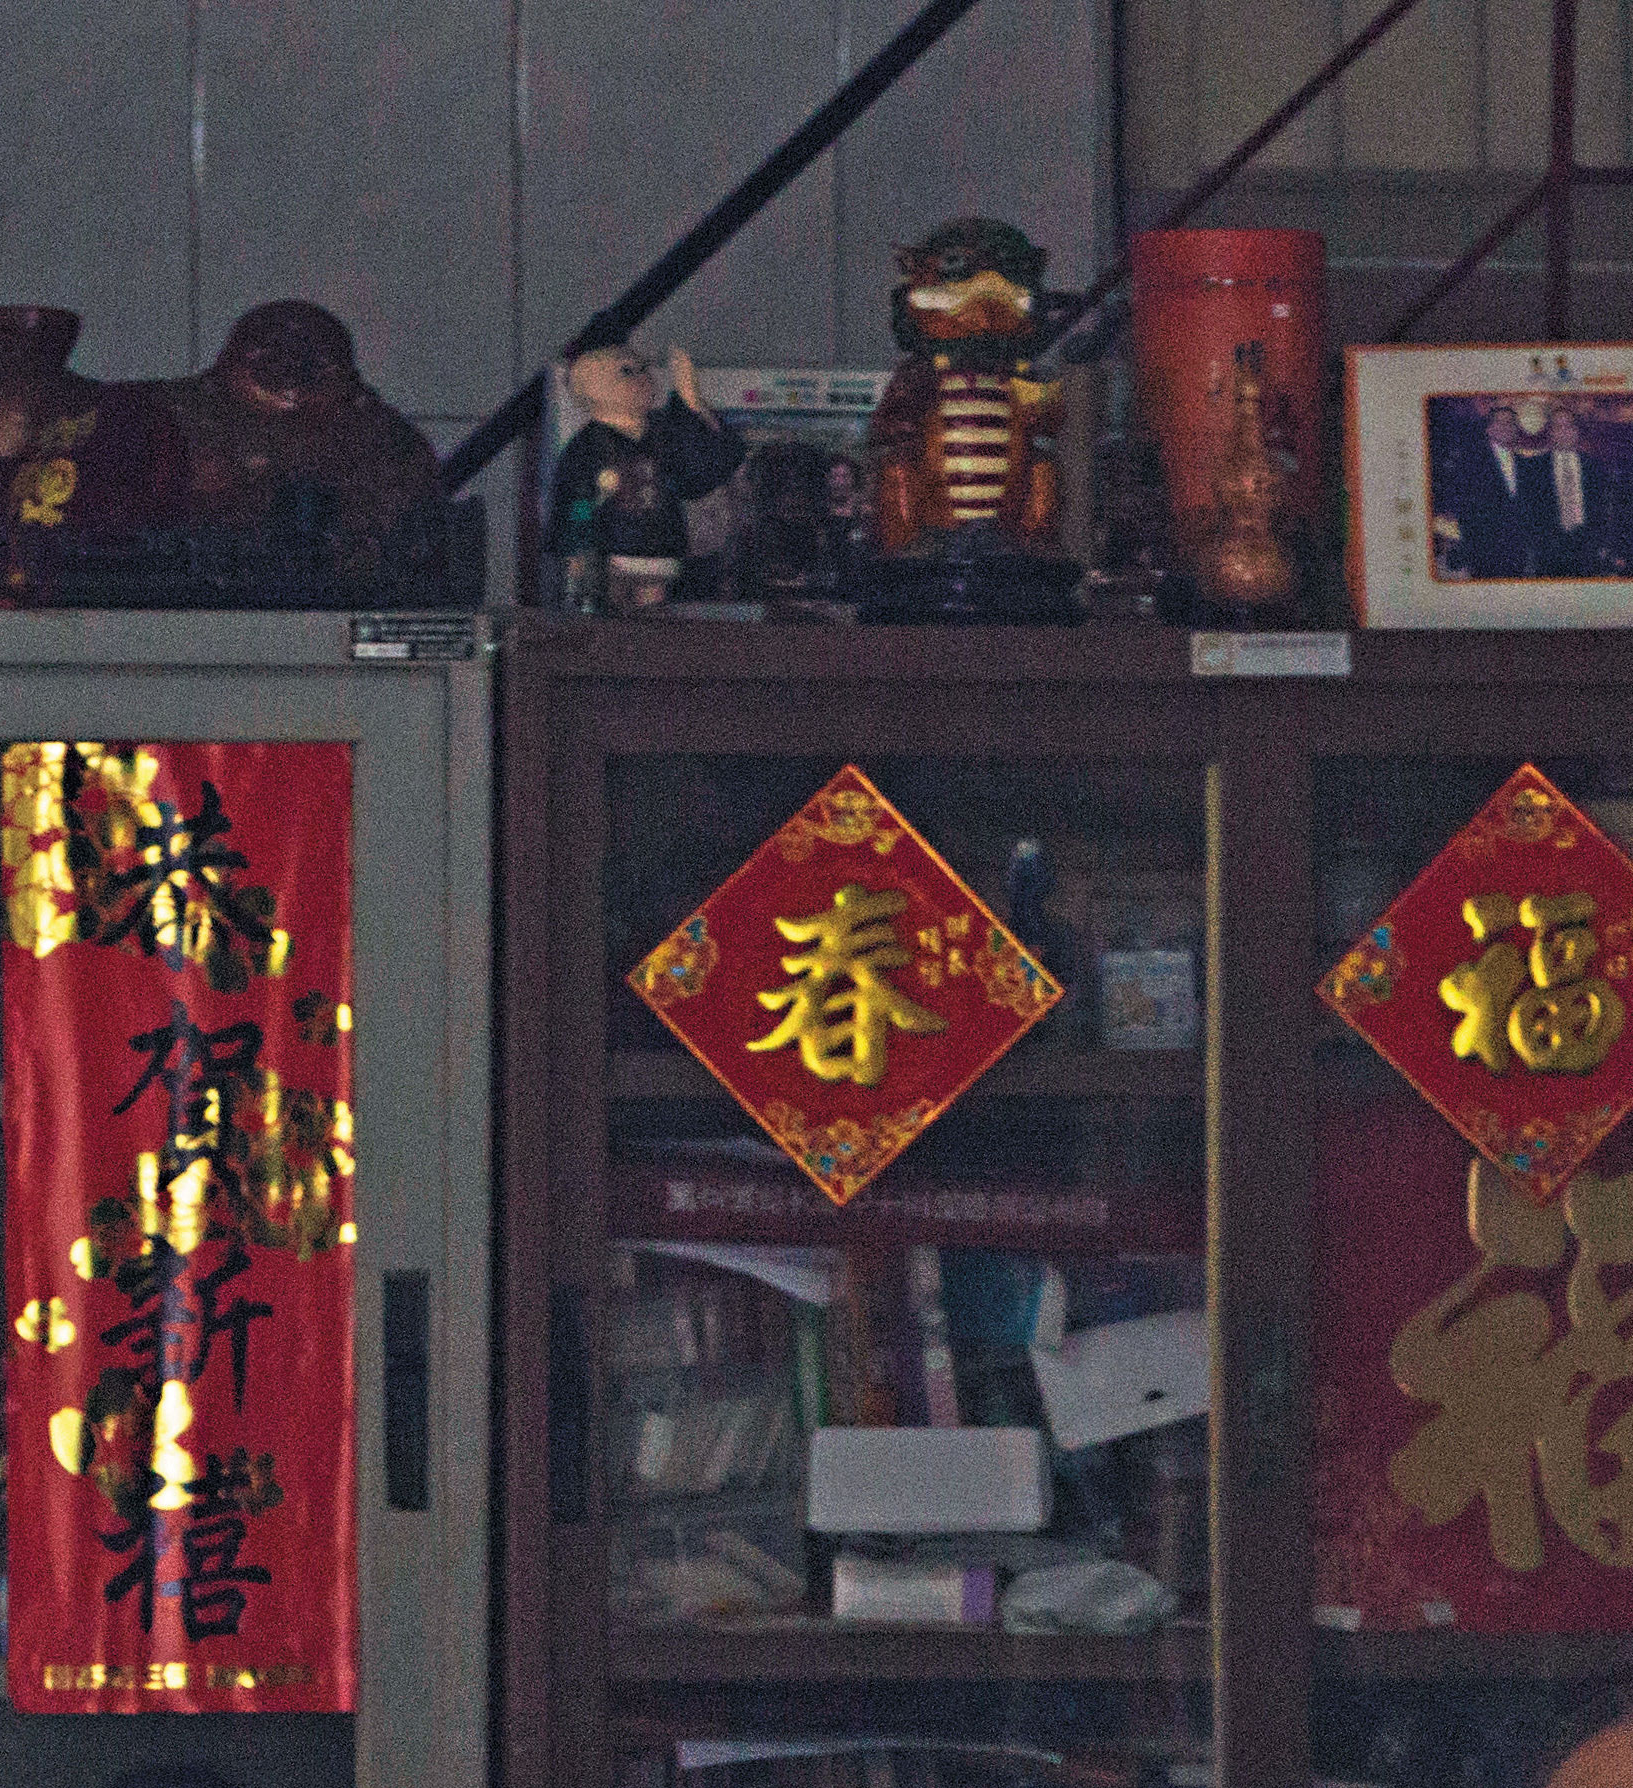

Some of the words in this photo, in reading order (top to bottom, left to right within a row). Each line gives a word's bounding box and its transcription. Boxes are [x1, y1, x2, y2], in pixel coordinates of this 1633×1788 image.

[746, 884, 948, 1086] 春
[1436, 891, 1626, 1075] 福
[96, 780, 274, 1641] 恭賀新禧
